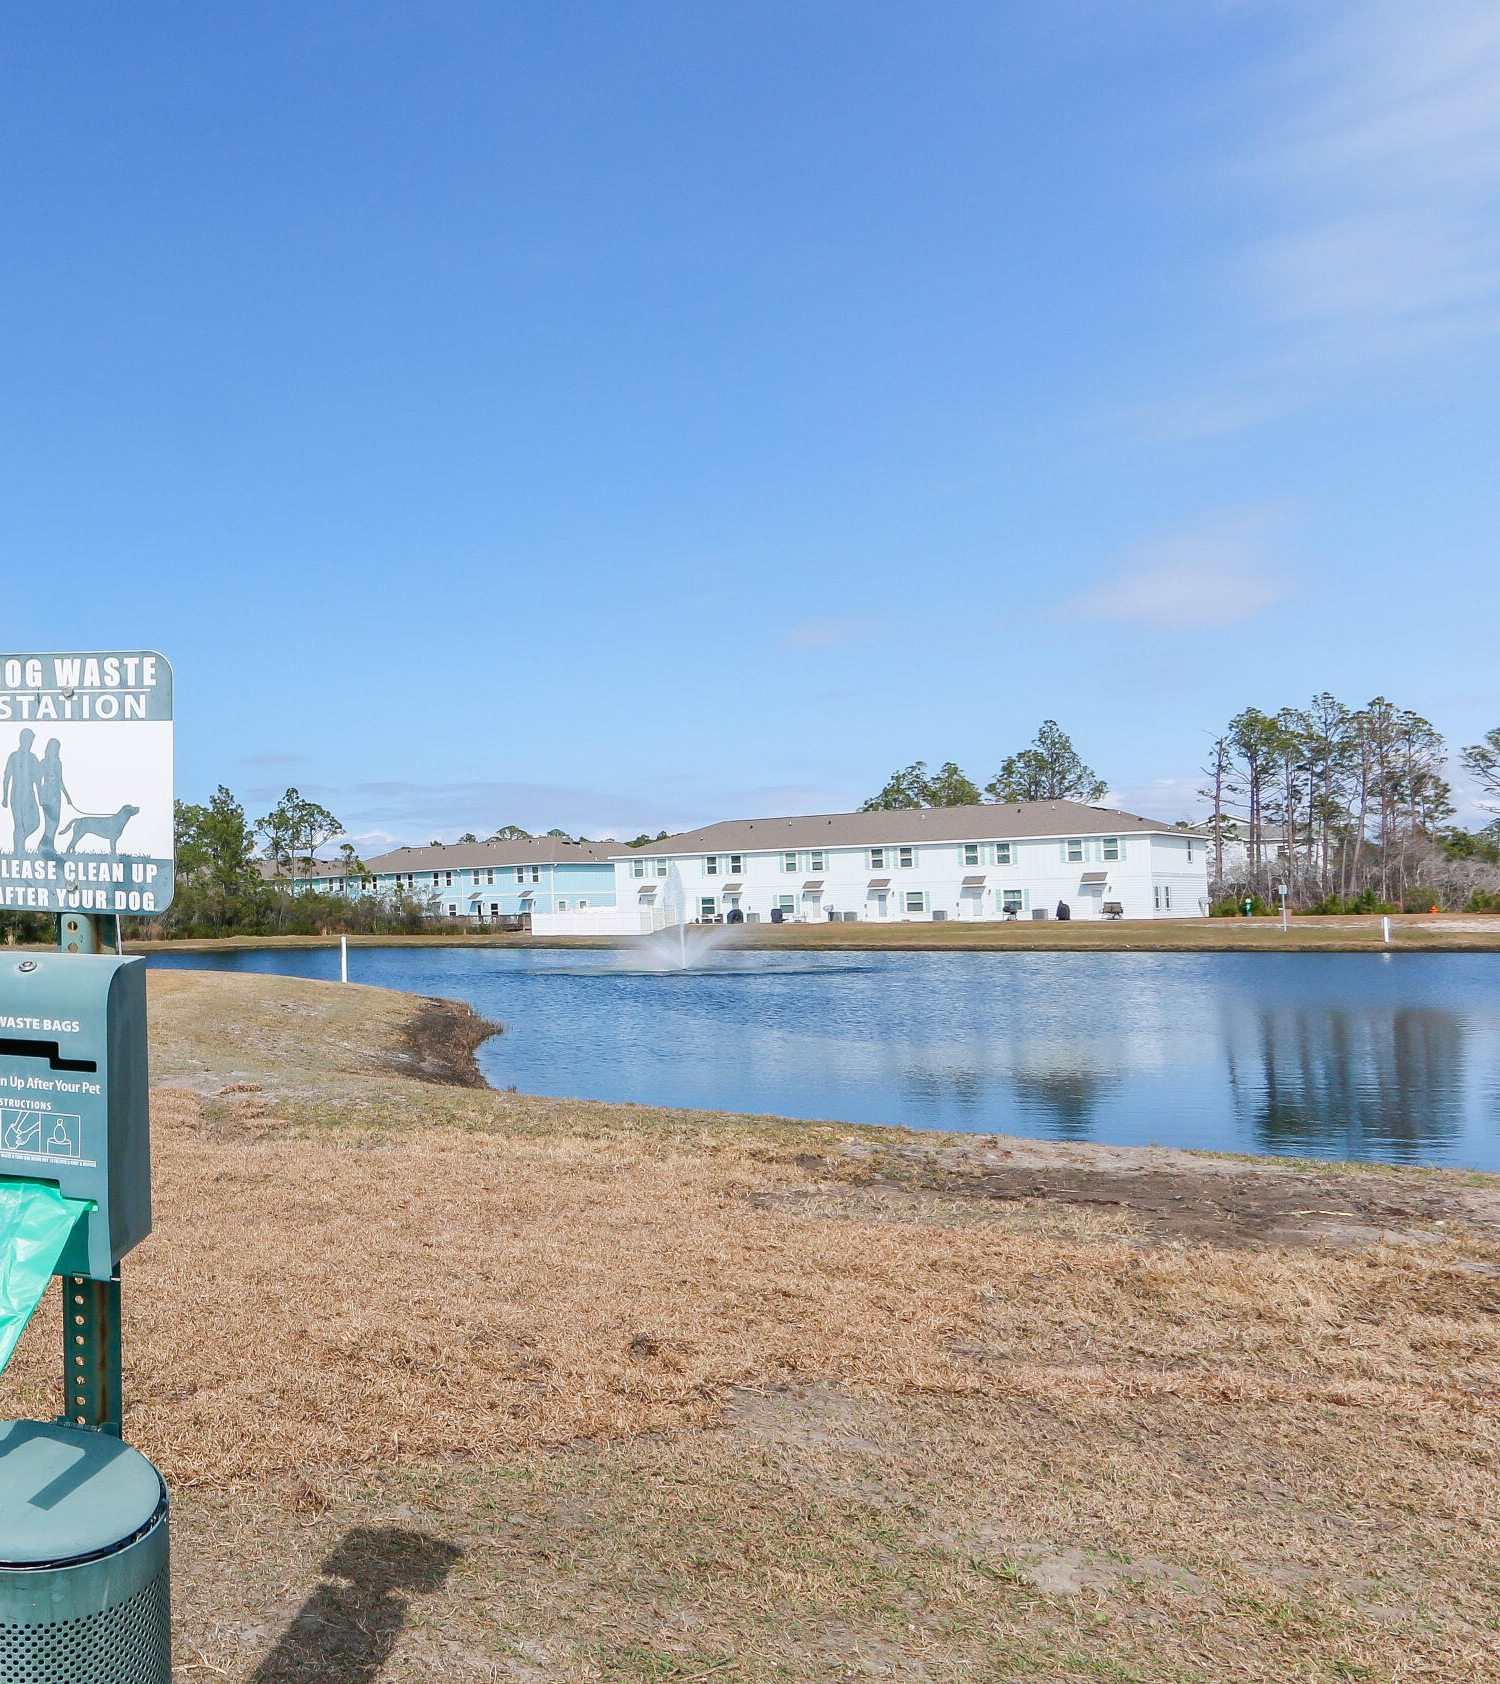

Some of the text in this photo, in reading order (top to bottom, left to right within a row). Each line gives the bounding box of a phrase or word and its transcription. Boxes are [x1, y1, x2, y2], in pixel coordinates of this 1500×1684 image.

[53, 656, 157, 687] WASTE
[63, 861, 124, 883] CLEAN
[131, 863, 158, 884] UP
[56, 889, 108, 909] YOUR
[114, 890, 156, 912] DOG
[43, 1019, 80, 1033] BAGS
[9, 1075, 25, 1090] Up
[26, 1077, 54, 1091] After
[54, 1079, 80, 1094] Your
[82, 1081, 101, 1095] Pet
